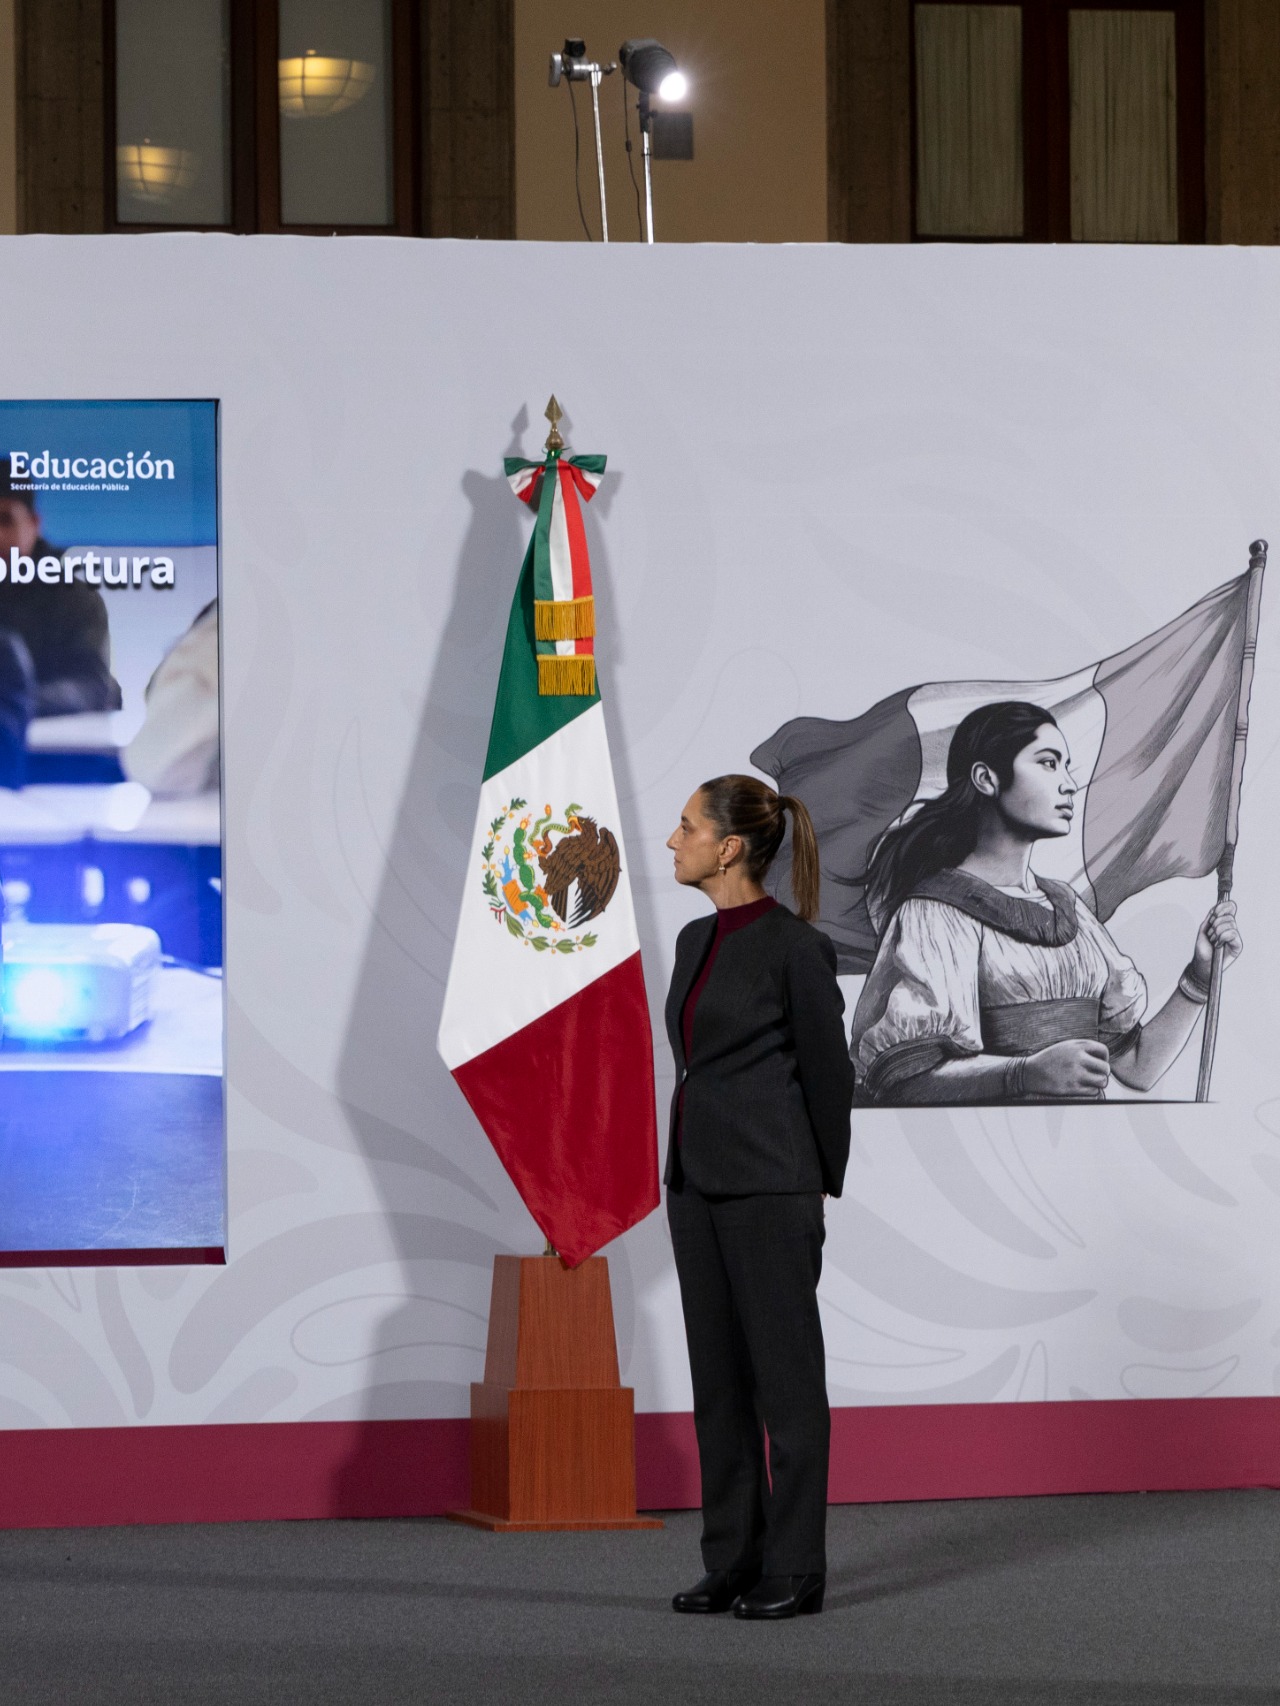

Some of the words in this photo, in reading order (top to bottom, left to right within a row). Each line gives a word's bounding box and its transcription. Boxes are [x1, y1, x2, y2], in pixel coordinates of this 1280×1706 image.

[9, 449, 175, 480] Educación
[10, 482, 49, 491] Secretaría
[50, 483, 61, 491] de
[61, 483, 101, 491] Educación
[101, 483, 130, 491] Pública
